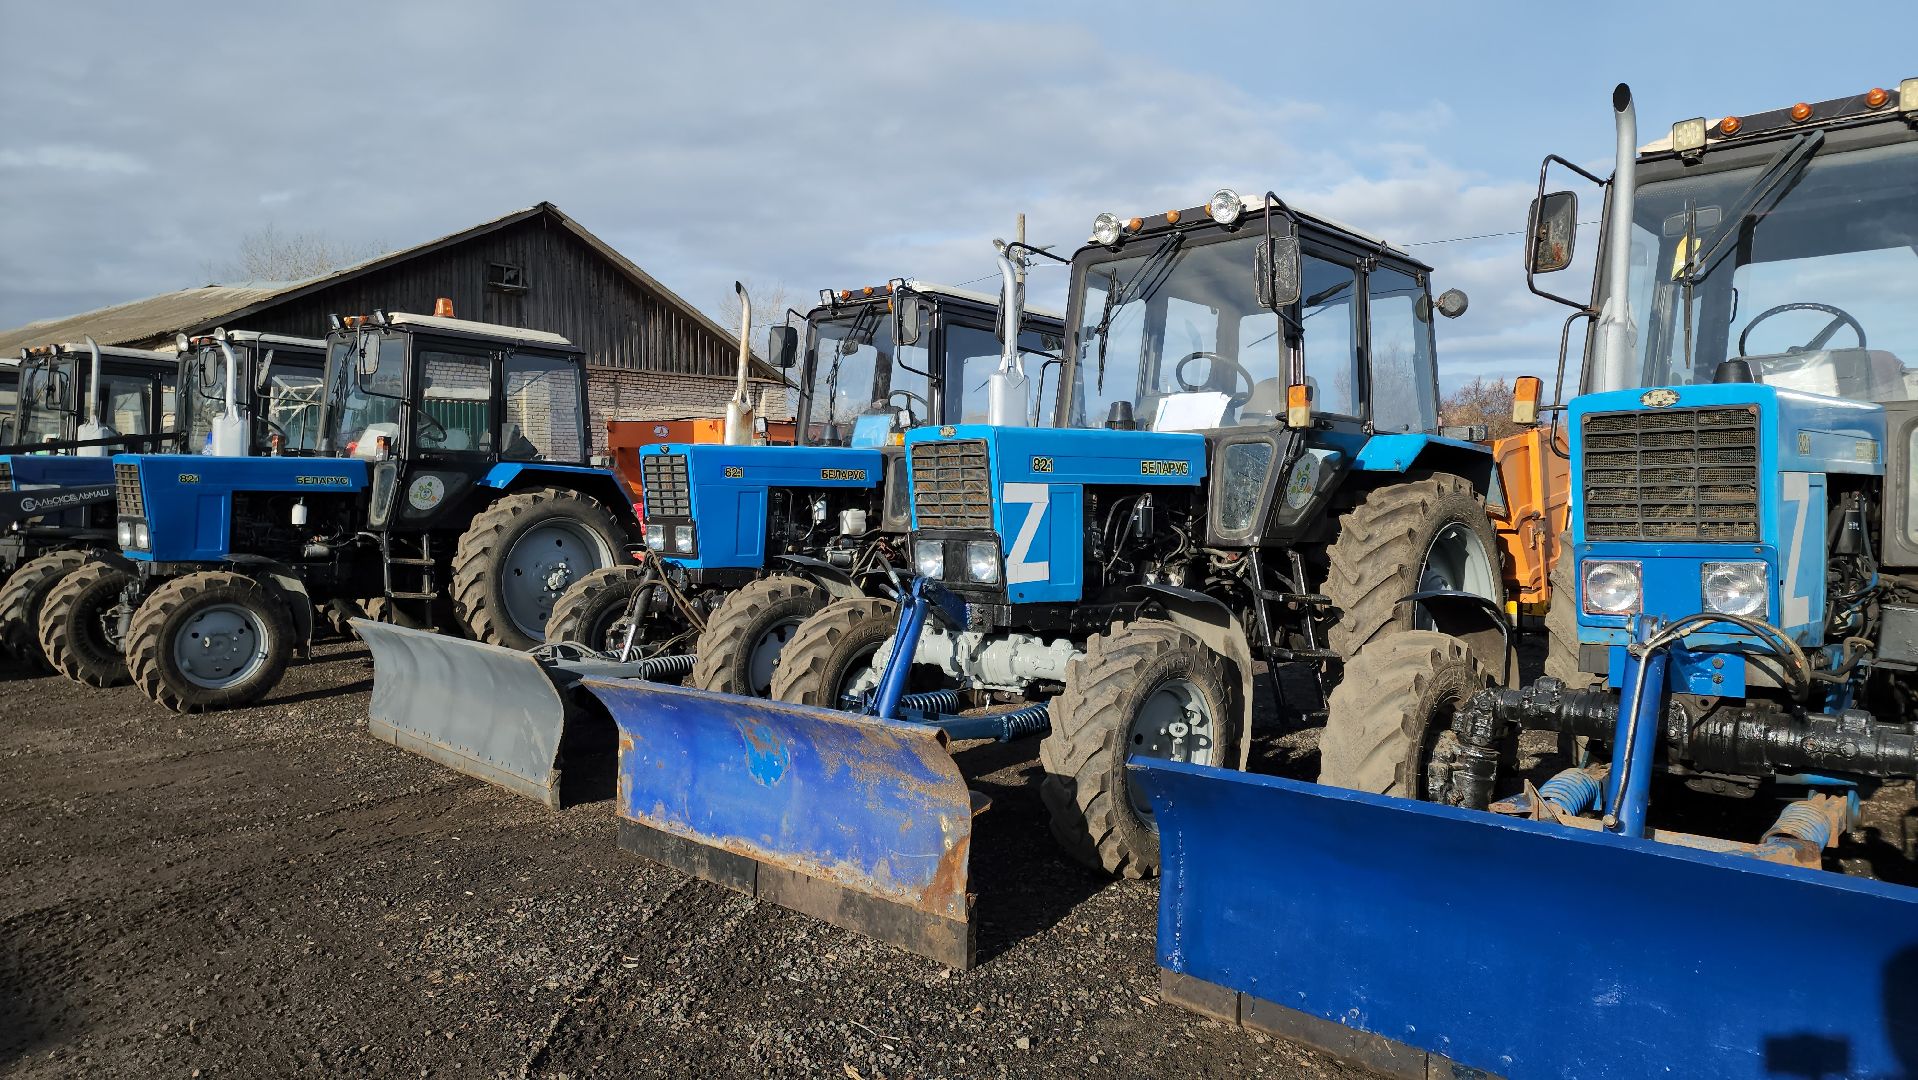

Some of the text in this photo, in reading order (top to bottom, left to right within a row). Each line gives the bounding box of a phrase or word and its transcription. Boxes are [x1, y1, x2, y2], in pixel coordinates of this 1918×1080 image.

[821, 468, 866, 481] БЕЛАРУС
[1140, 459, 1189, 476] БЕЛАРУС
[296, 475, 349, 486] БЕЛАРУС
[1003, 482, 1050, 585] Z
[1783, 472, 1810, 629] Z
